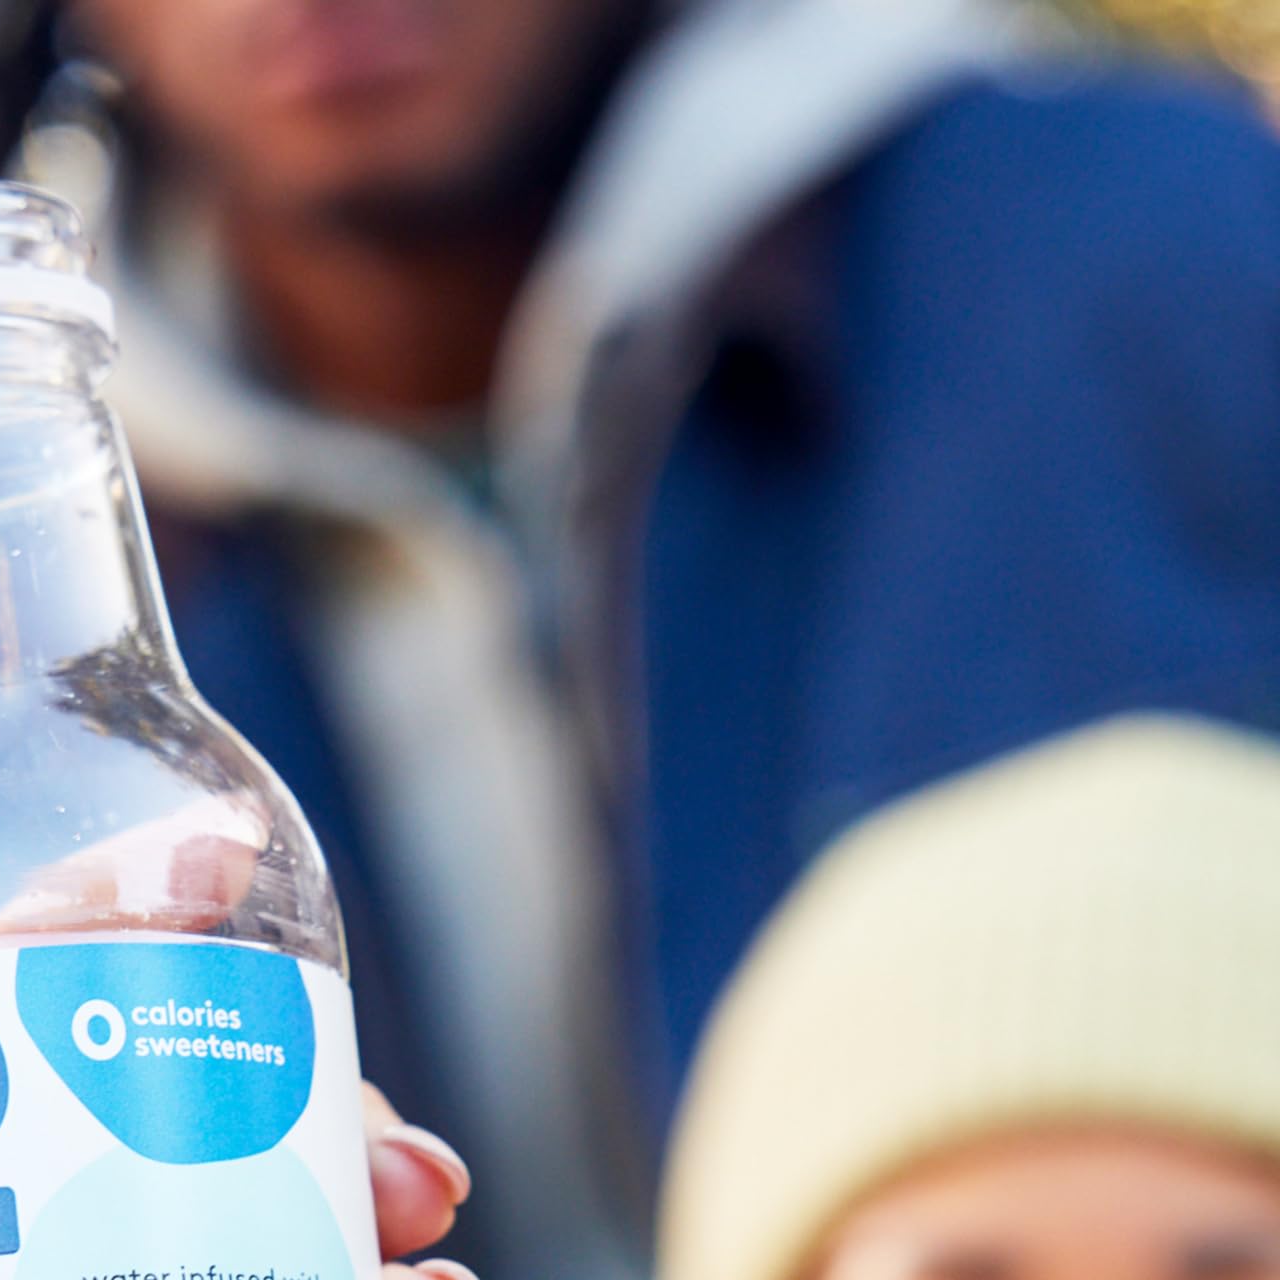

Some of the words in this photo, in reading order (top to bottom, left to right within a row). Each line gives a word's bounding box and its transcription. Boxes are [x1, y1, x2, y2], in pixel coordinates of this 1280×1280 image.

[71, 998, 127, 1061] 0
[131, 998, 242, 1030] calories
[134, 1034, 286, 1066] sweeteners
